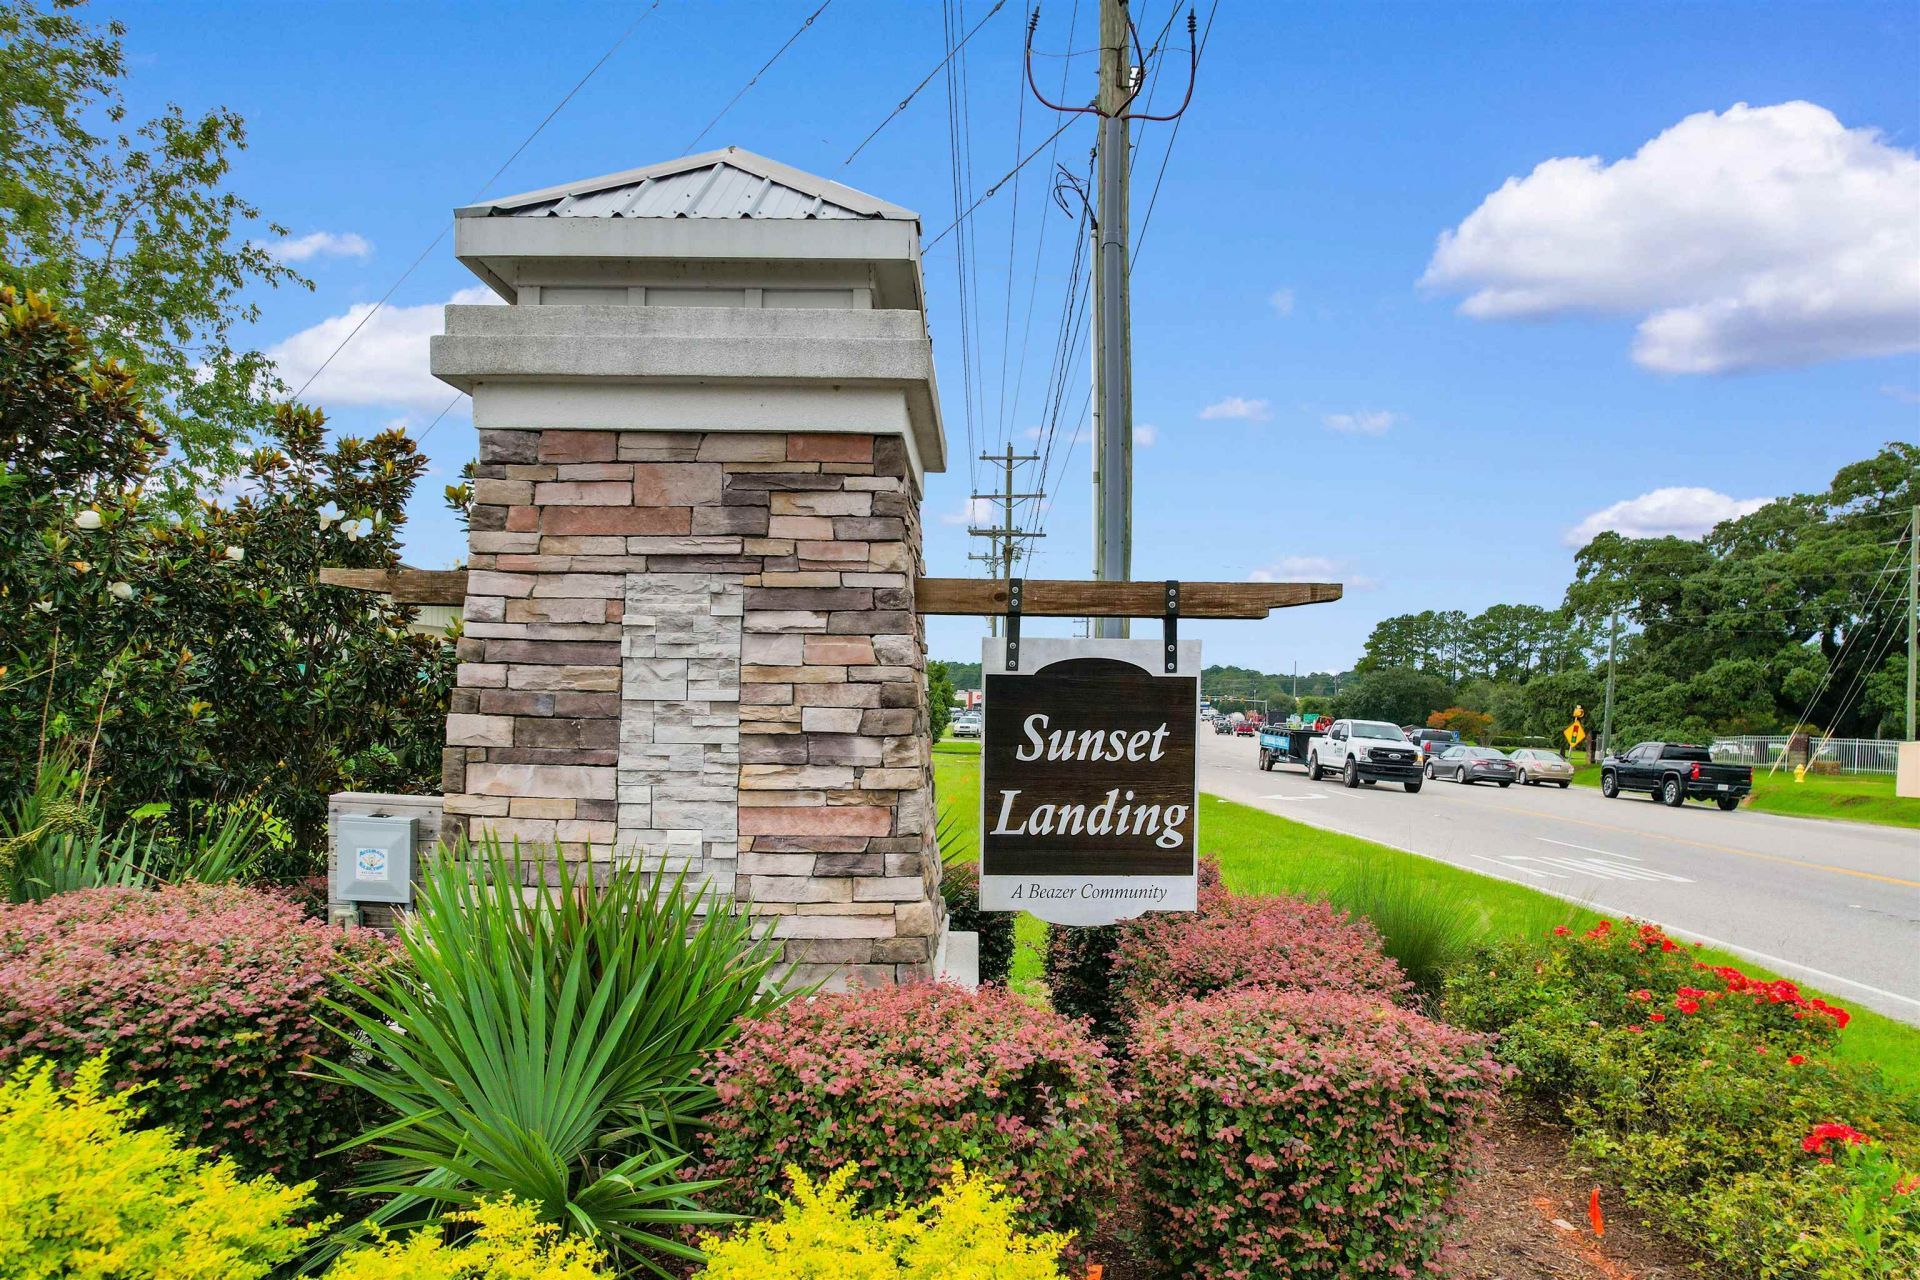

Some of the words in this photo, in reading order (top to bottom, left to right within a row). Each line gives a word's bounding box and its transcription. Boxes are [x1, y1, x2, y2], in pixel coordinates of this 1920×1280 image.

[1015, 713, 1170, 762] Sunset
[989, 788, 1189, 849] Landing
[1011, 883, 1023, 899] A
[1028, 883, 1077, 899] Beazer
[1081, 883, 1168, 903] Community
